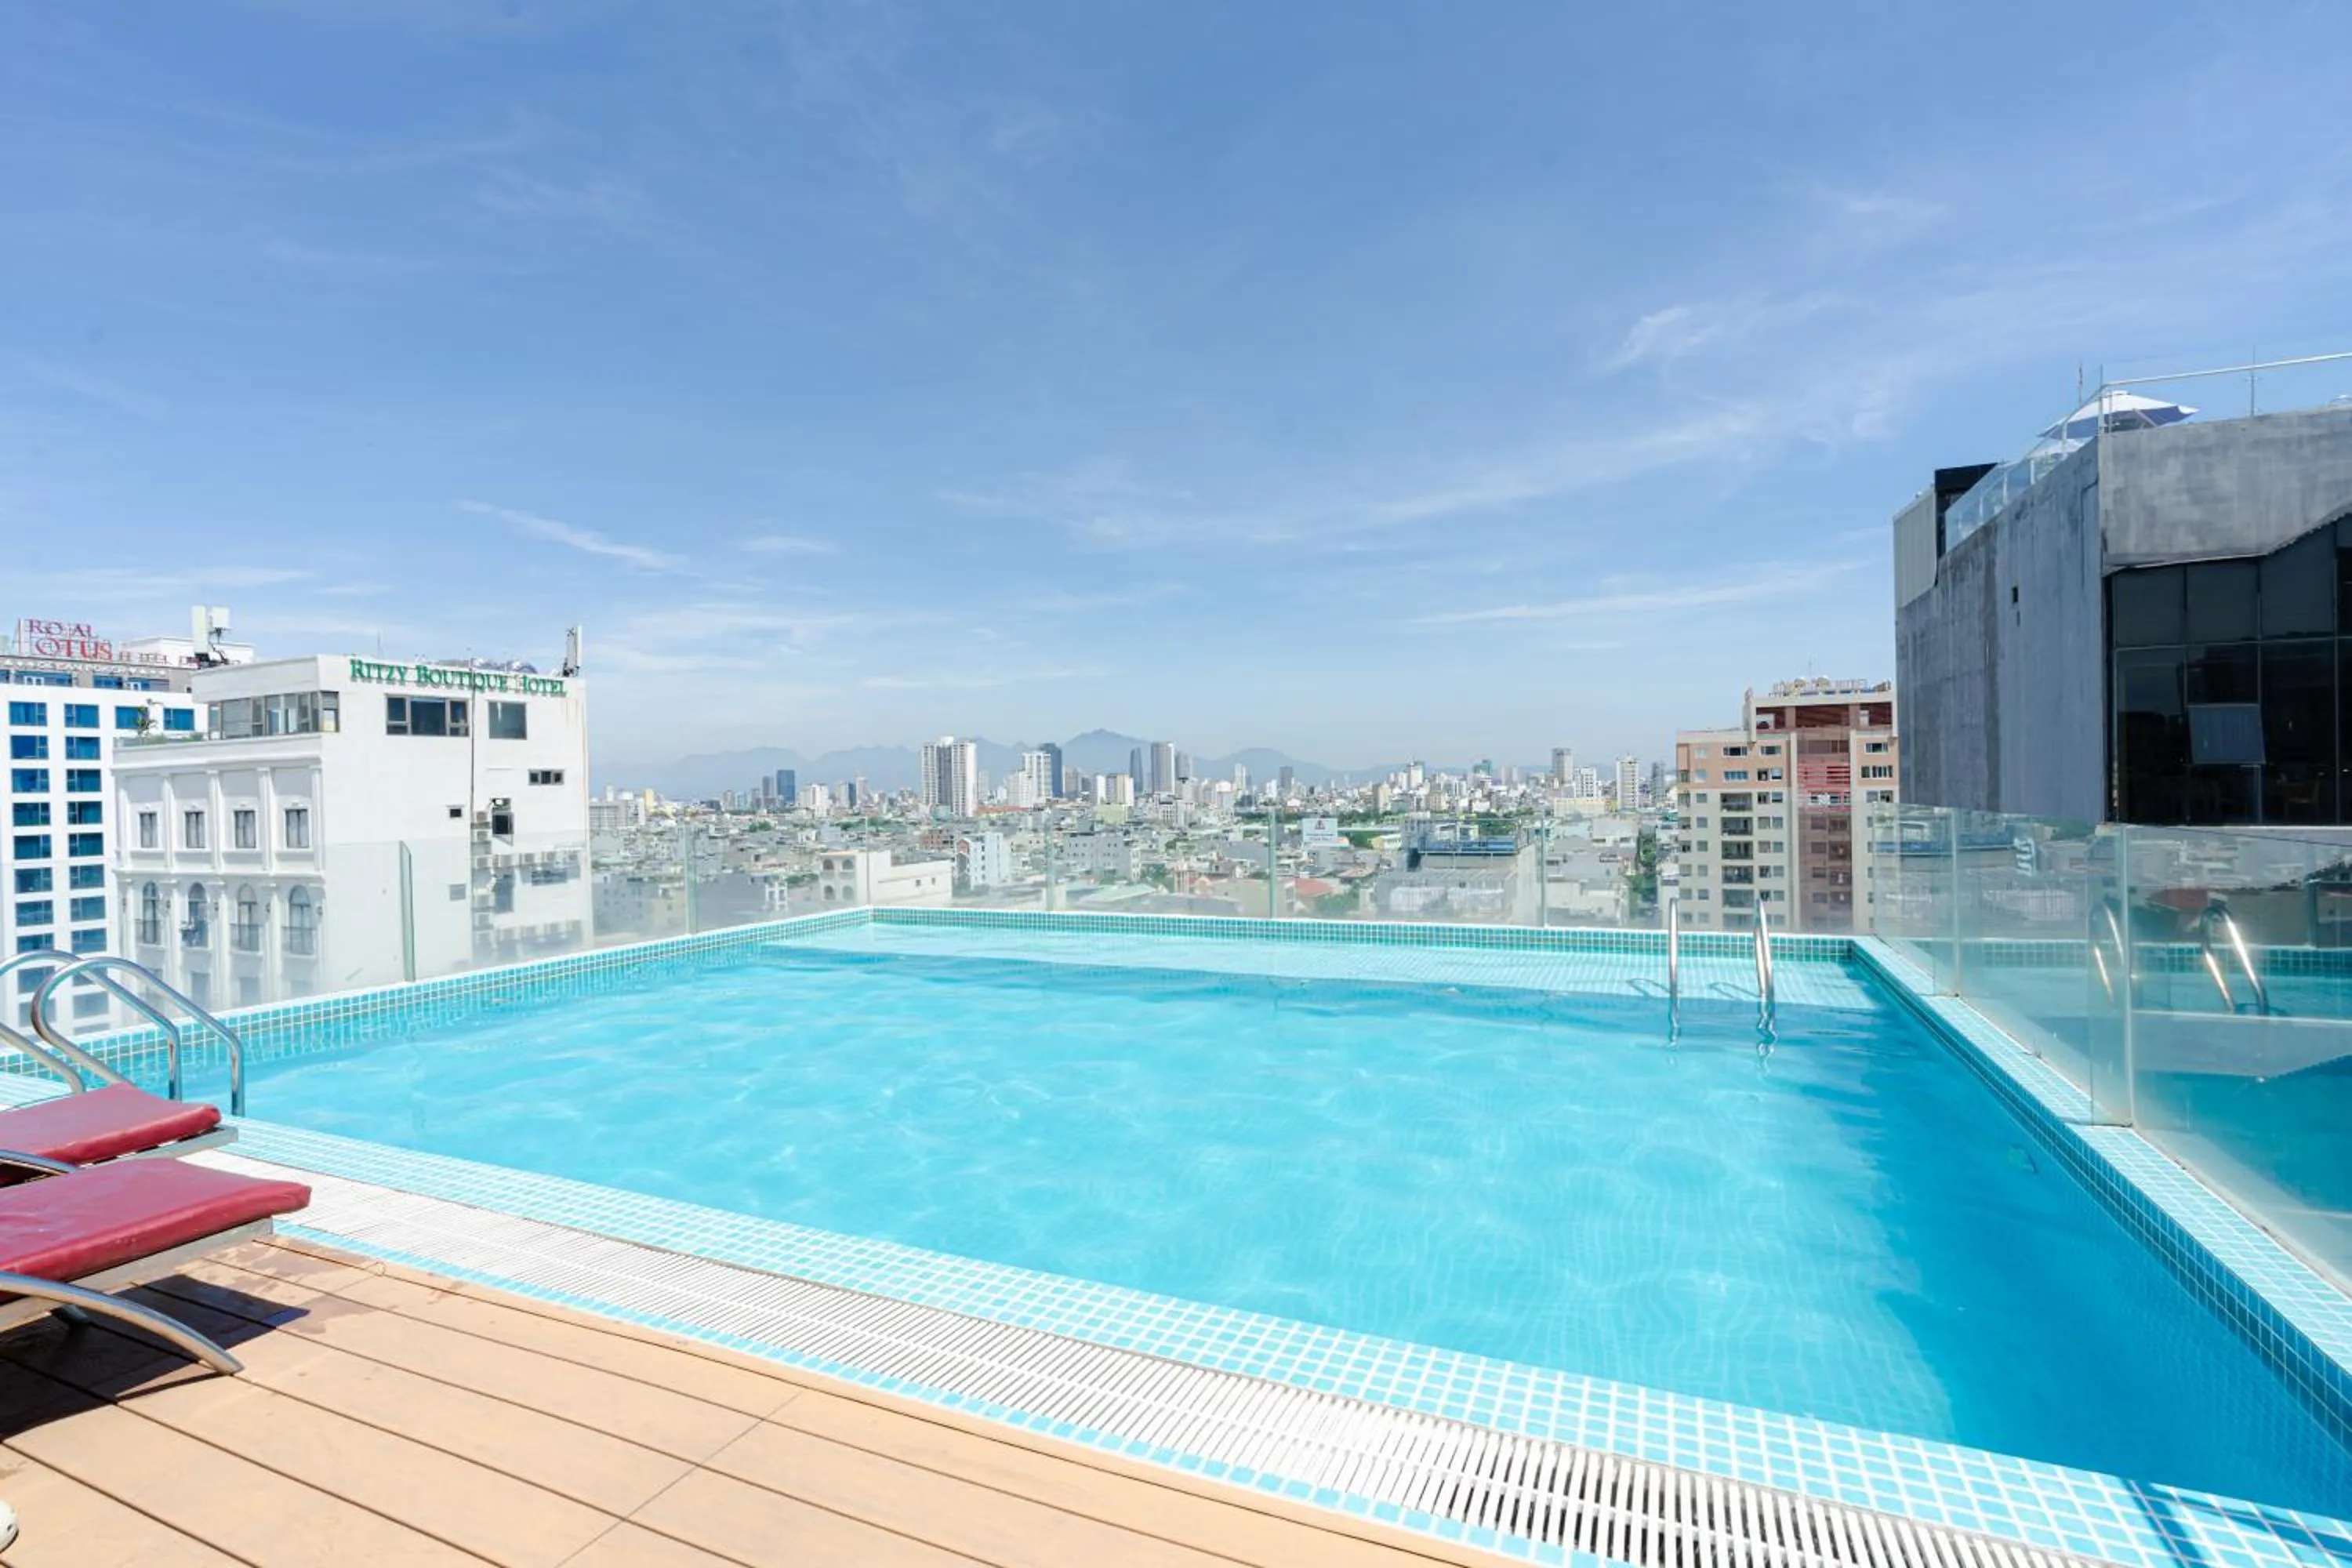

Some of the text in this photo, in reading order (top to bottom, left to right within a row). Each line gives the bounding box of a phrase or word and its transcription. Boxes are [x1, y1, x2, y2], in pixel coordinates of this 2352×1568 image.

[28, 619, 97, 637] ROAL
[350, 659, 408, 681] RITZY
[416, 665, 508, 691] BOUTIQUE
